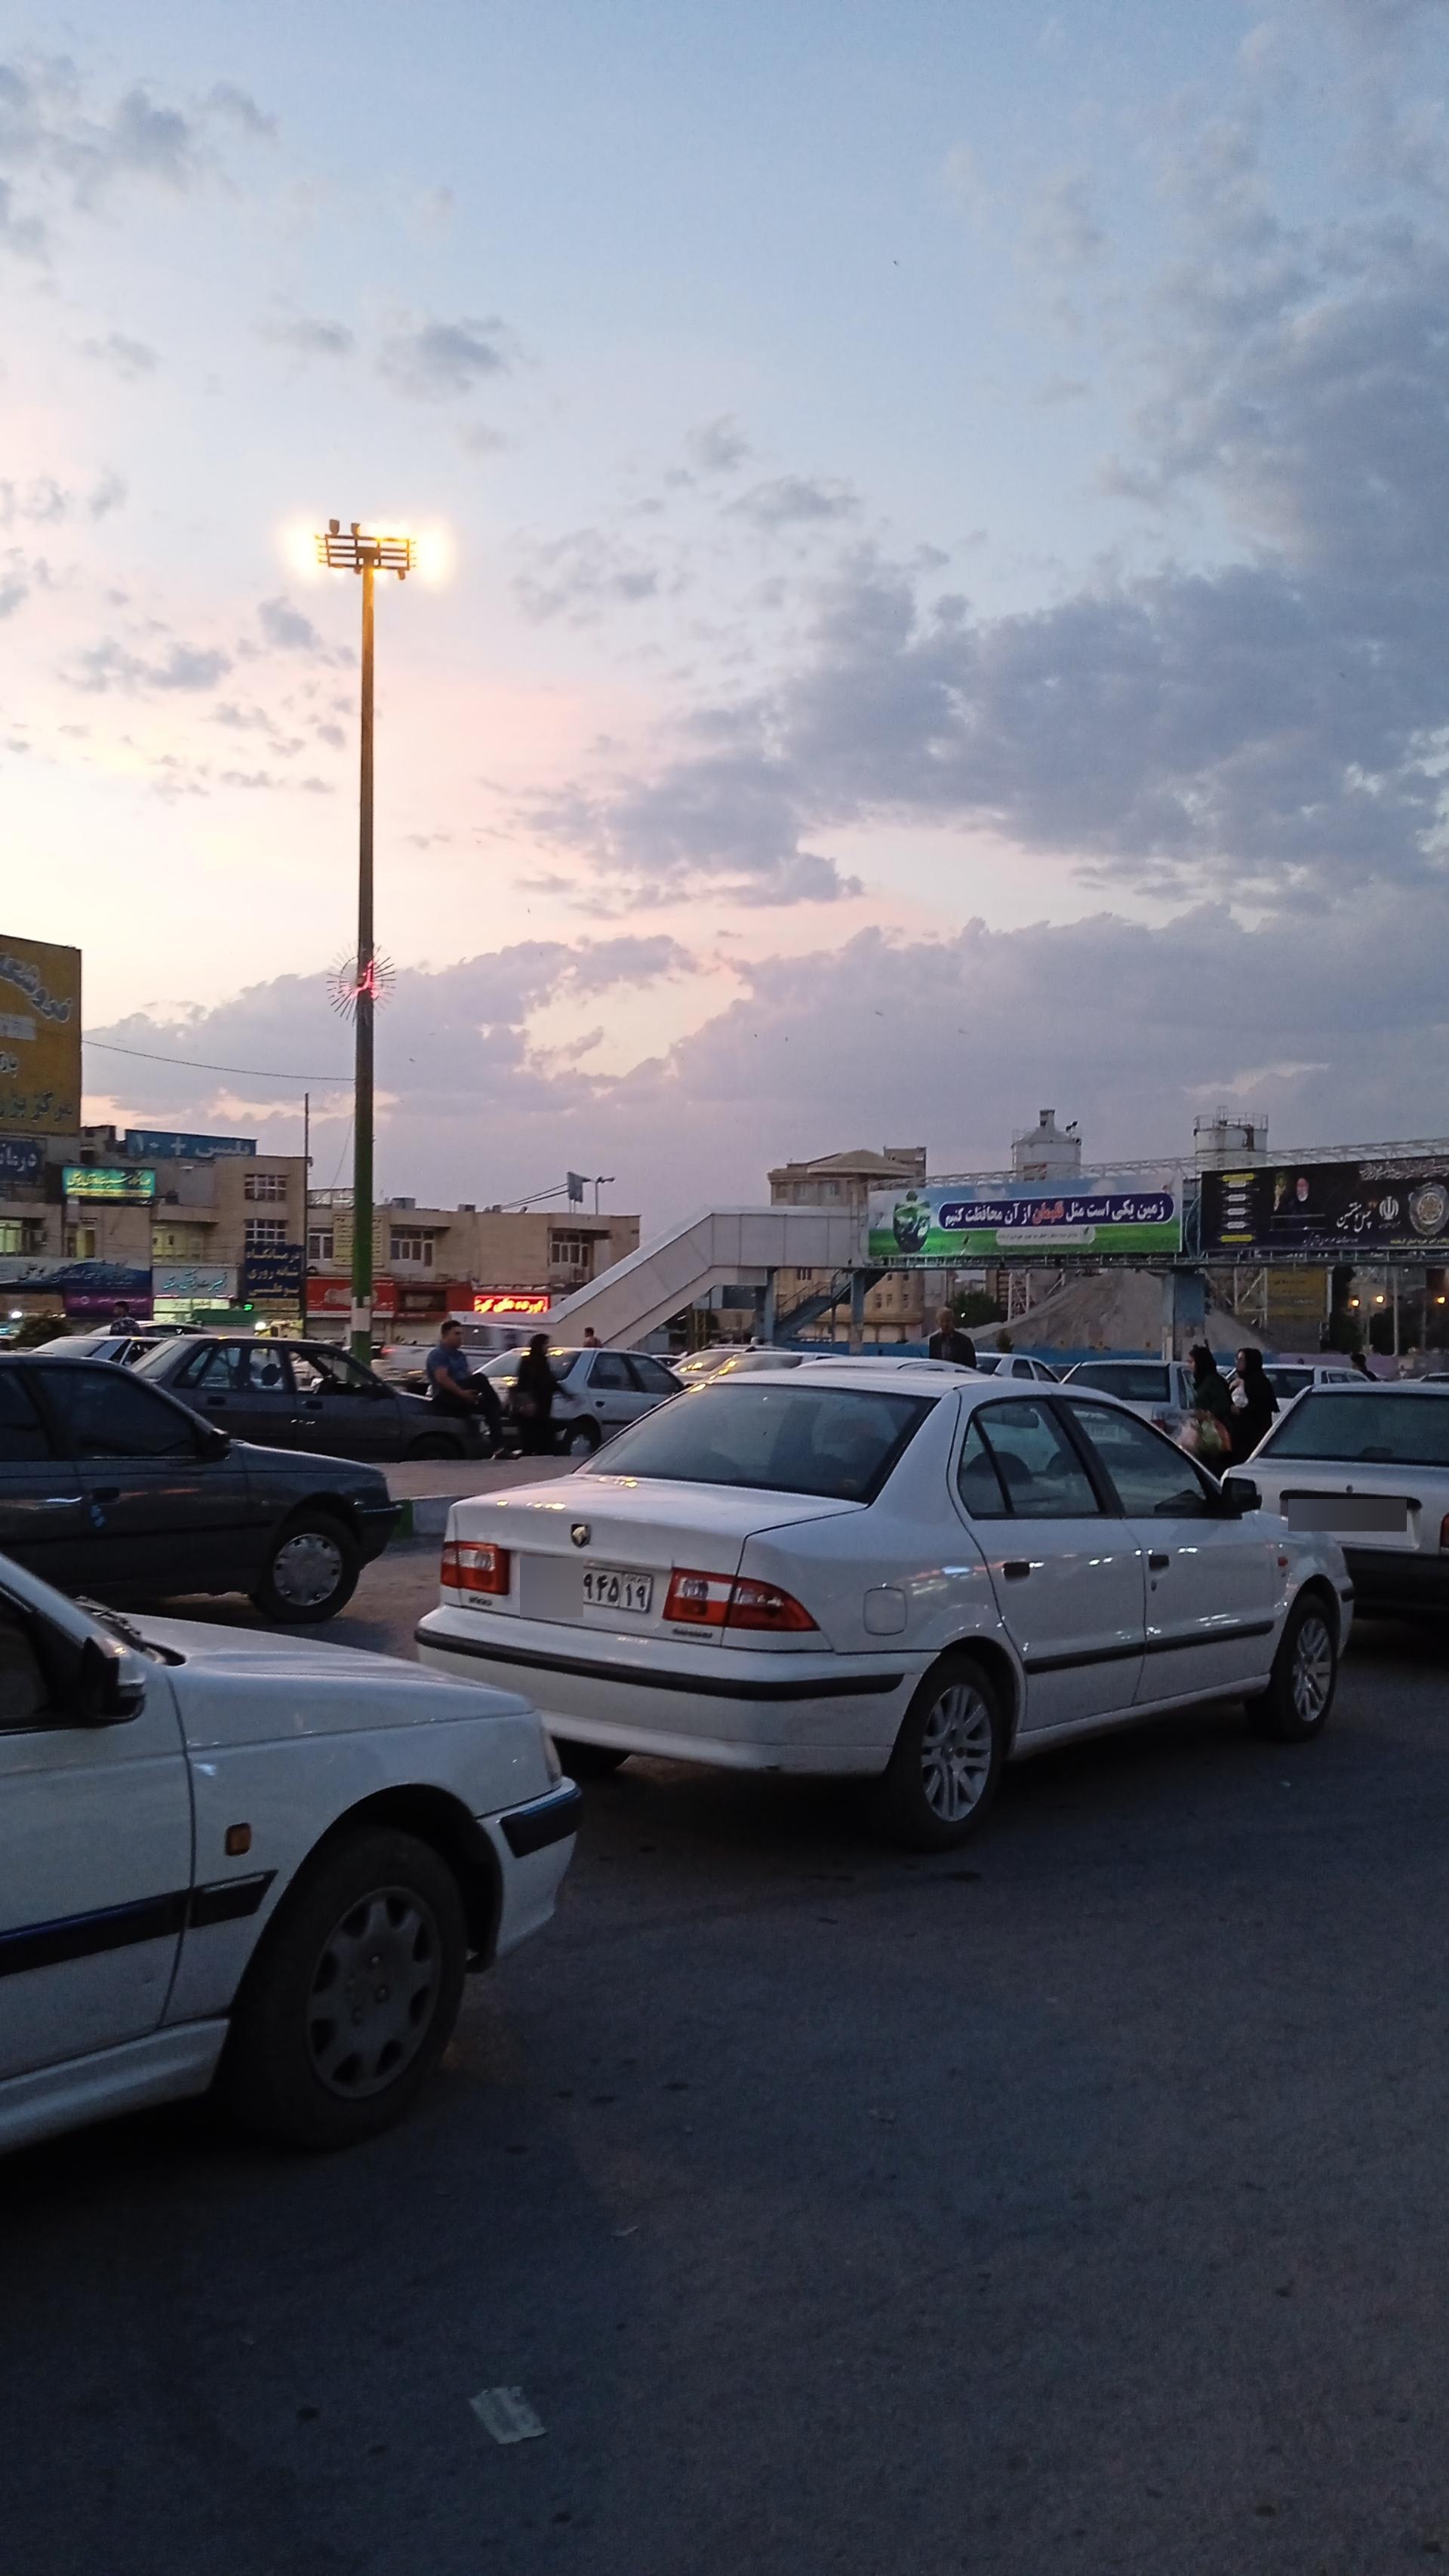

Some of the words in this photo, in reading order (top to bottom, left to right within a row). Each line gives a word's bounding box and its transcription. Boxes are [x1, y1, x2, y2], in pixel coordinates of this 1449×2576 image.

[945, 1207, 964, 1227] کنیم
[964, 1205, 1003, 1221] محافظت
[1004, 1202, 1020, 1225] آن
[1021, 1204, 1032, 1224] از
[1066, 1202, 1084, 1222] مثل
[1087, 1199, 1110, 1217] است
[1111, 1199, 1134, 1221] یکی
[1137, 1200, 1164, 1220] زمین
[583, 1574, 619, 1602] ۹۴۵
[626, 1583, 646, 1608] ۱۹
